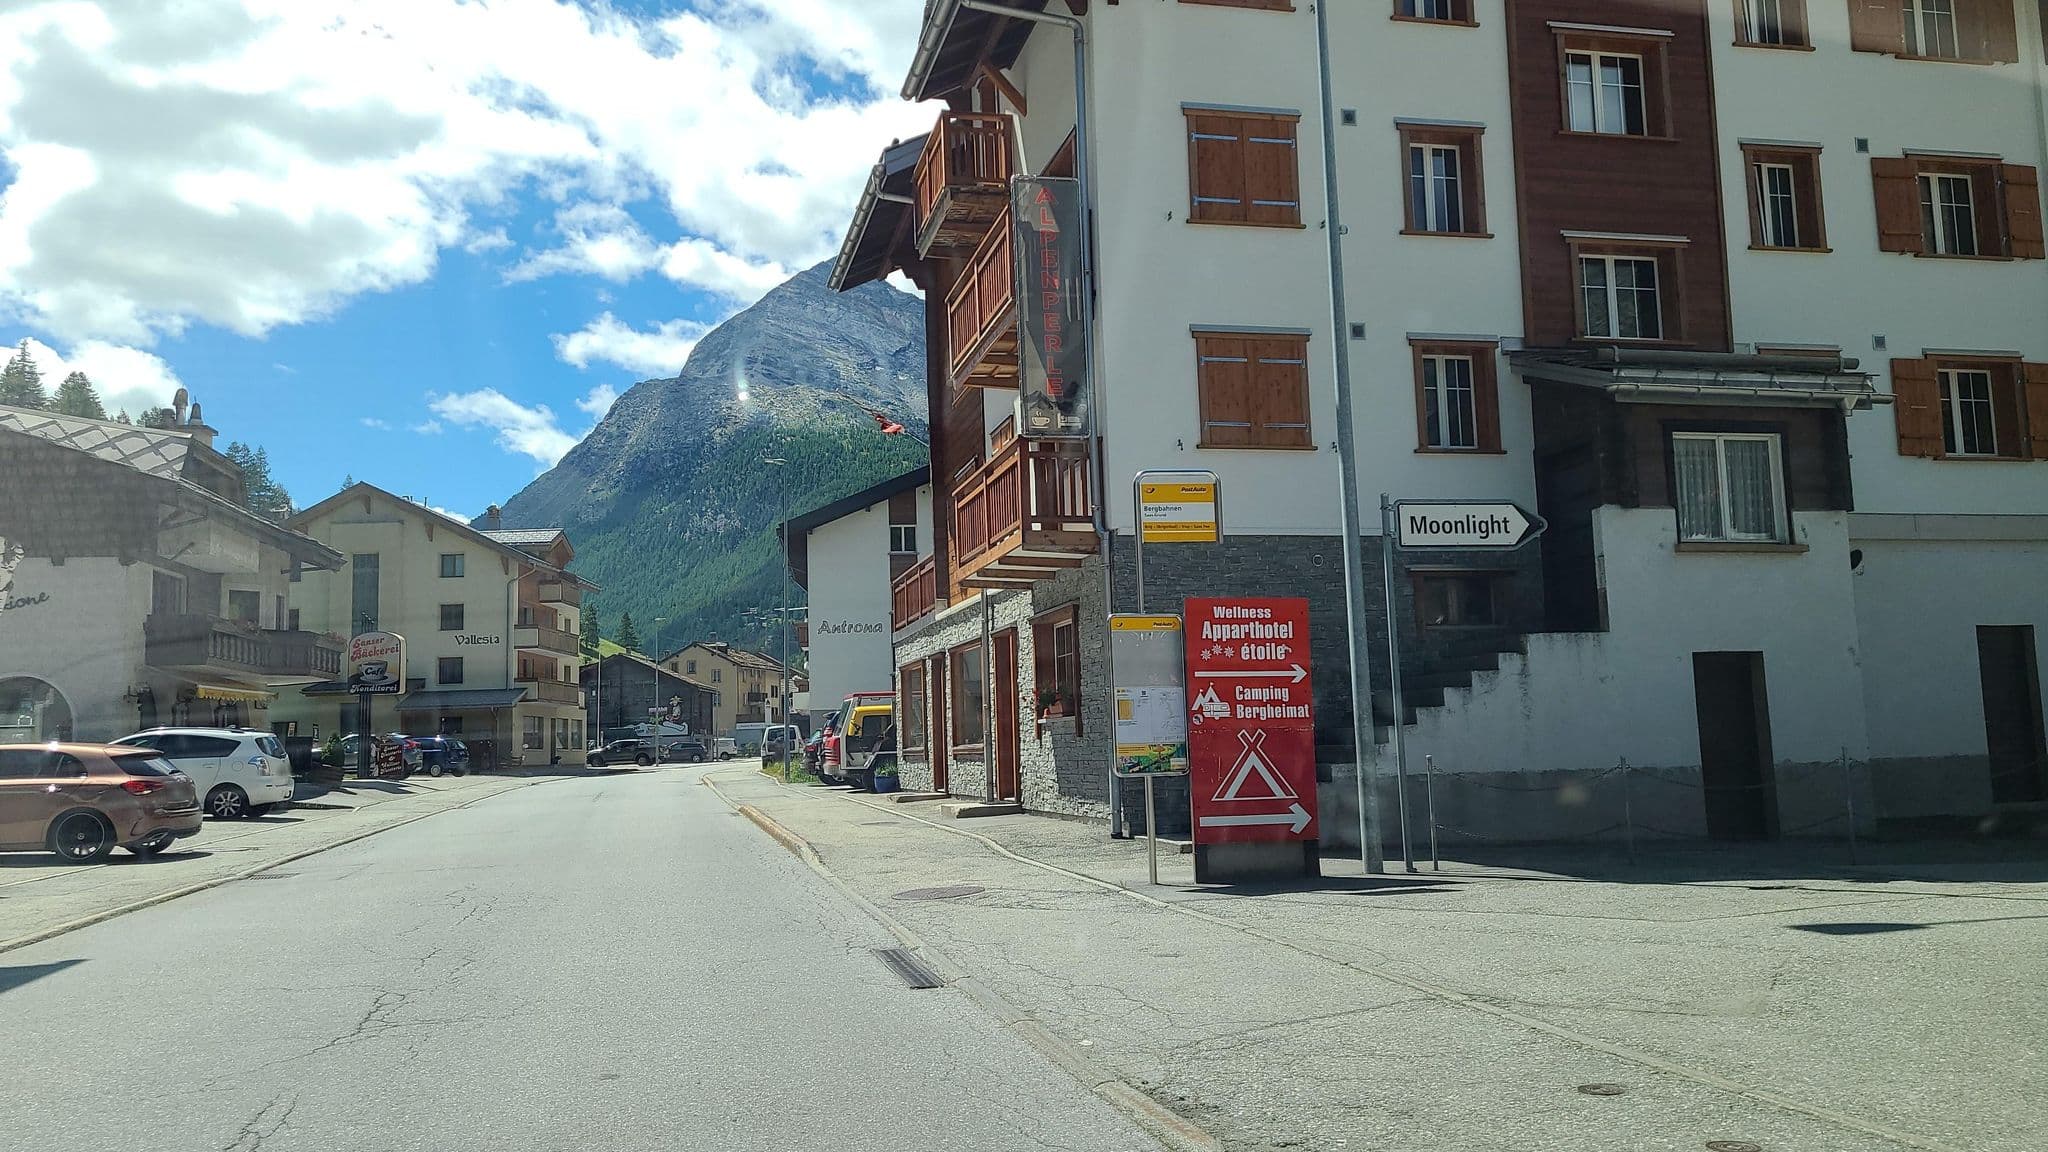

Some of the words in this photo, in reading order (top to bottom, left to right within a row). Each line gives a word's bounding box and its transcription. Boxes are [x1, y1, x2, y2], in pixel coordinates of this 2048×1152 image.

[1035, 186, 1063, 397] ALPENPERLE
[1181, 486, 1207, 494] PostAuto
[1143, 505, 1183, 513] Bergbahnen
[1409, 514, 1511, 540] Moonlight
[1213, 606, 1272, 619] Wellness
[818, 620, 883, 634] Antrona
[1202, 621, 1293, 642] Apparthotel
[454, 634, 500, 645] Vallesia
[351, 643, 399, 661] Bäckerei
[1241, 642, 1287, 660] étoile
[1235, 685, 1289, 702] Camping
[1236, 703, 1310, 720] Bergheimat
